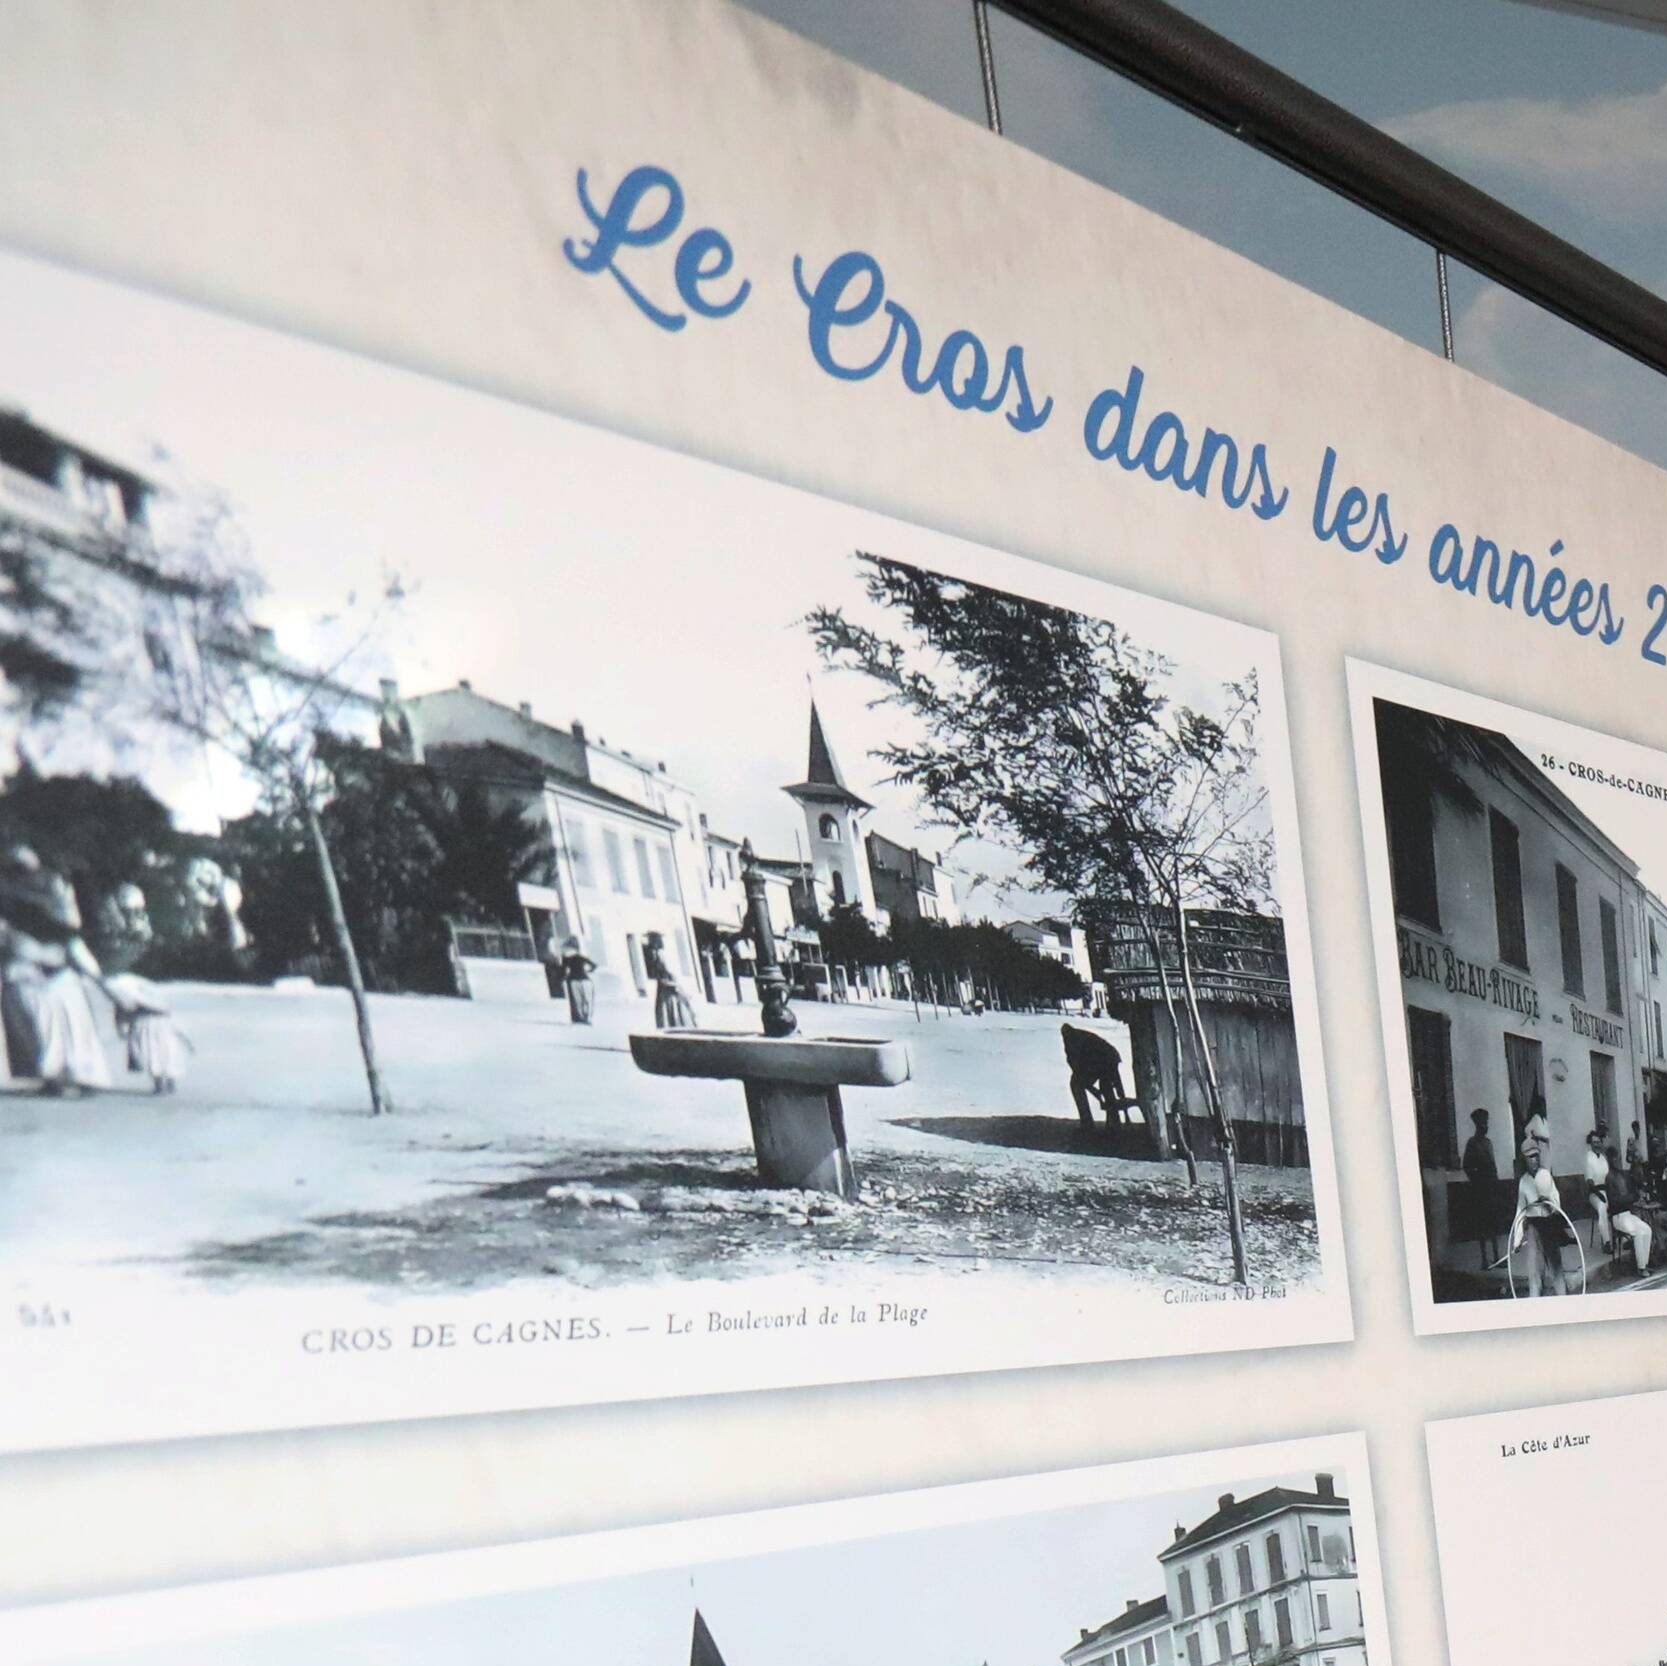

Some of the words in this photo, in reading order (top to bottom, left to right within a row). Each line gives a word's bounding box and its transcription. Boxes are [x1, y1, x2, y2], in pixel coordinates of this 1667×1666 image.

[562, 165, 752, 332] Le
[792, 251, 1054, 433] Cros
[1083, 365, 1289, 521] dans
[1312, 445, 1409, 565] les
[1429, 539, 1625, 647] années
[1541, 754, 1555, 770] 26
[1402, 930, 1440, 984] BAR
[1443, 948, 1541, 1020] BEAU-RIVAGE
[1569, 1003, 1624, 1049] RESTAURANT
[1233, 1286, 1255, 1300] ND
[301, 1327, 393, 1355] CROS
[411, 1324, 456, 1348] DE
[472, 1317, 611, 1347] CAGNES.
[666, 1313, 693, 1335] Le
[708, 1305, 808, 1333] Boulevard
[818, 1304, 840, 1326] de
[850, 1303, 867, 1324] la
[878, 1301, 929, 1331] Plage
[1501, 1445, 1516, 1458] La
[1521, 1440, 1548, 1455] Côte
[1553, 1434, 1591, 1450] d'Azur
